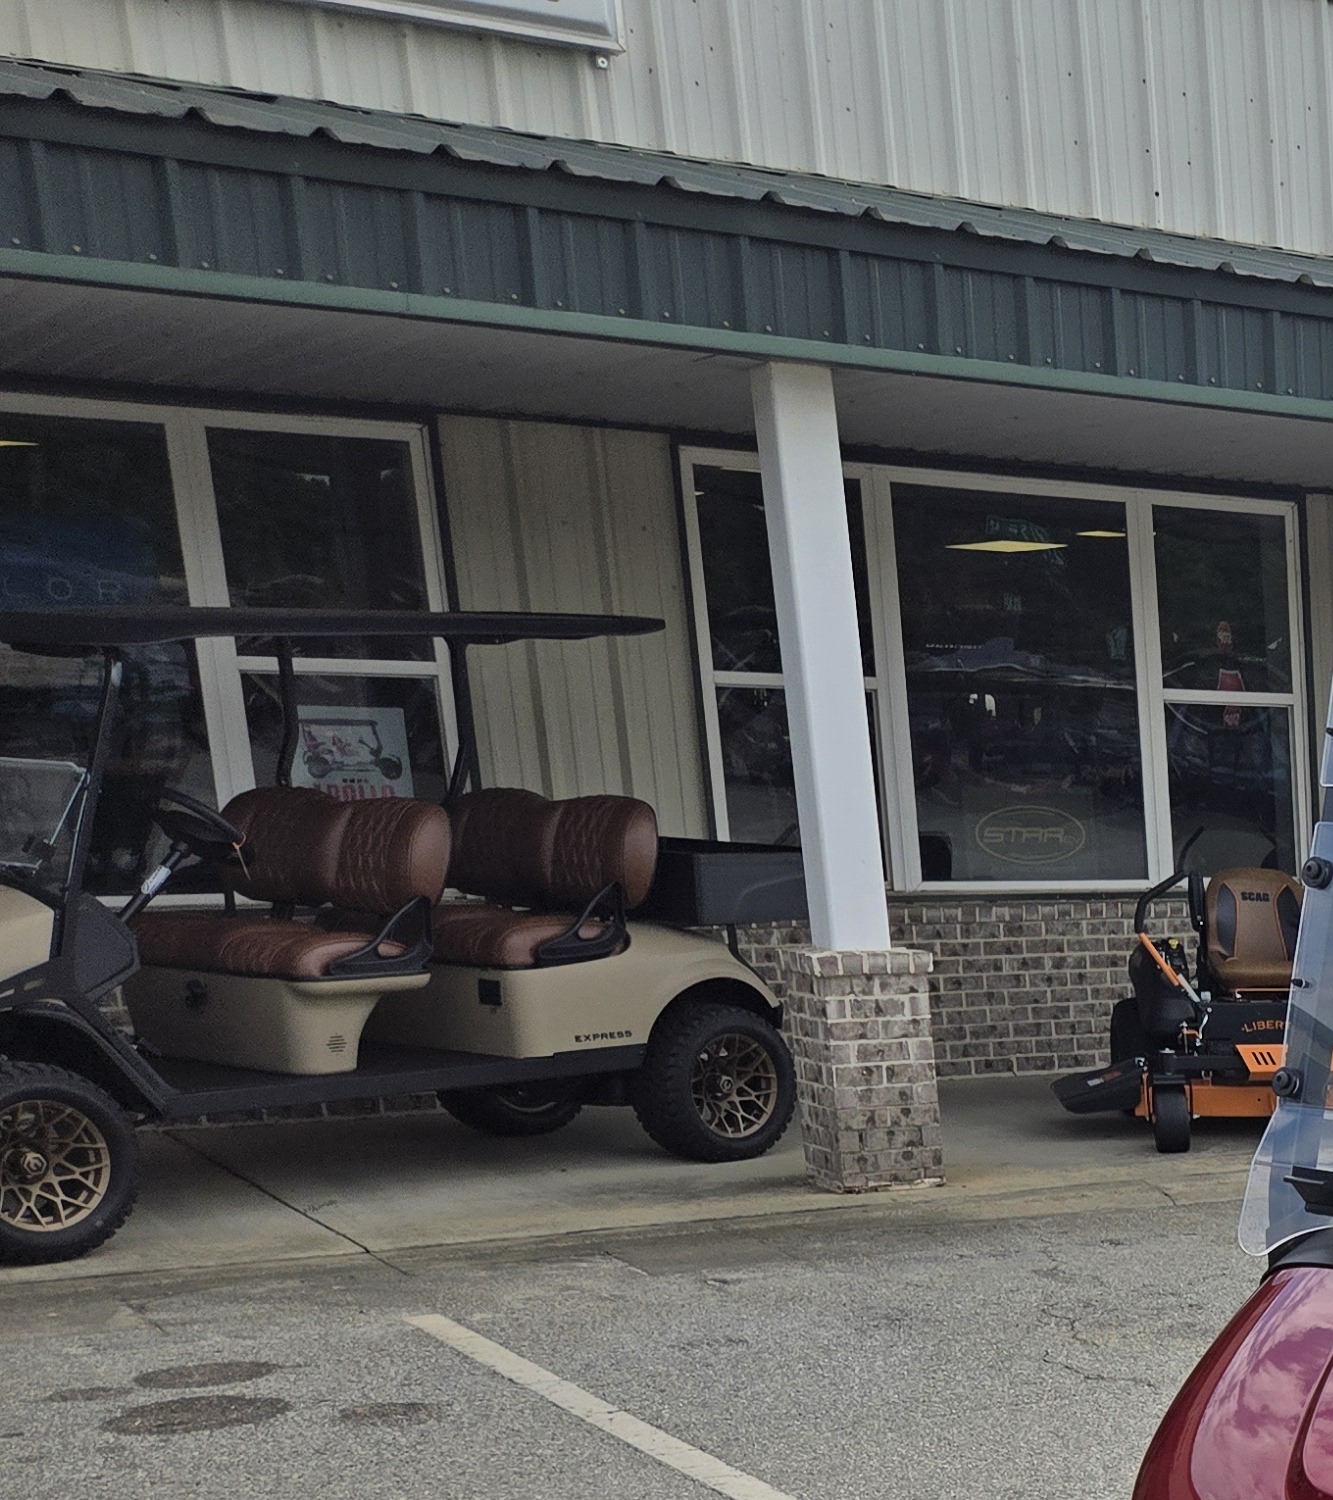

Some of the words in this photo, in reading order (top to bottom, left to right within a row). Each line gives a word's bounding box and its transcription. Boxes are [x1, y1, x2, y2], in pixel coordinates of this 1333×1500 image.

[984, 827, 1065, 844] STAR
[1241, 891, 1270, 903] SCAG
[574, 1030, 633, 1043] EXPRESS
